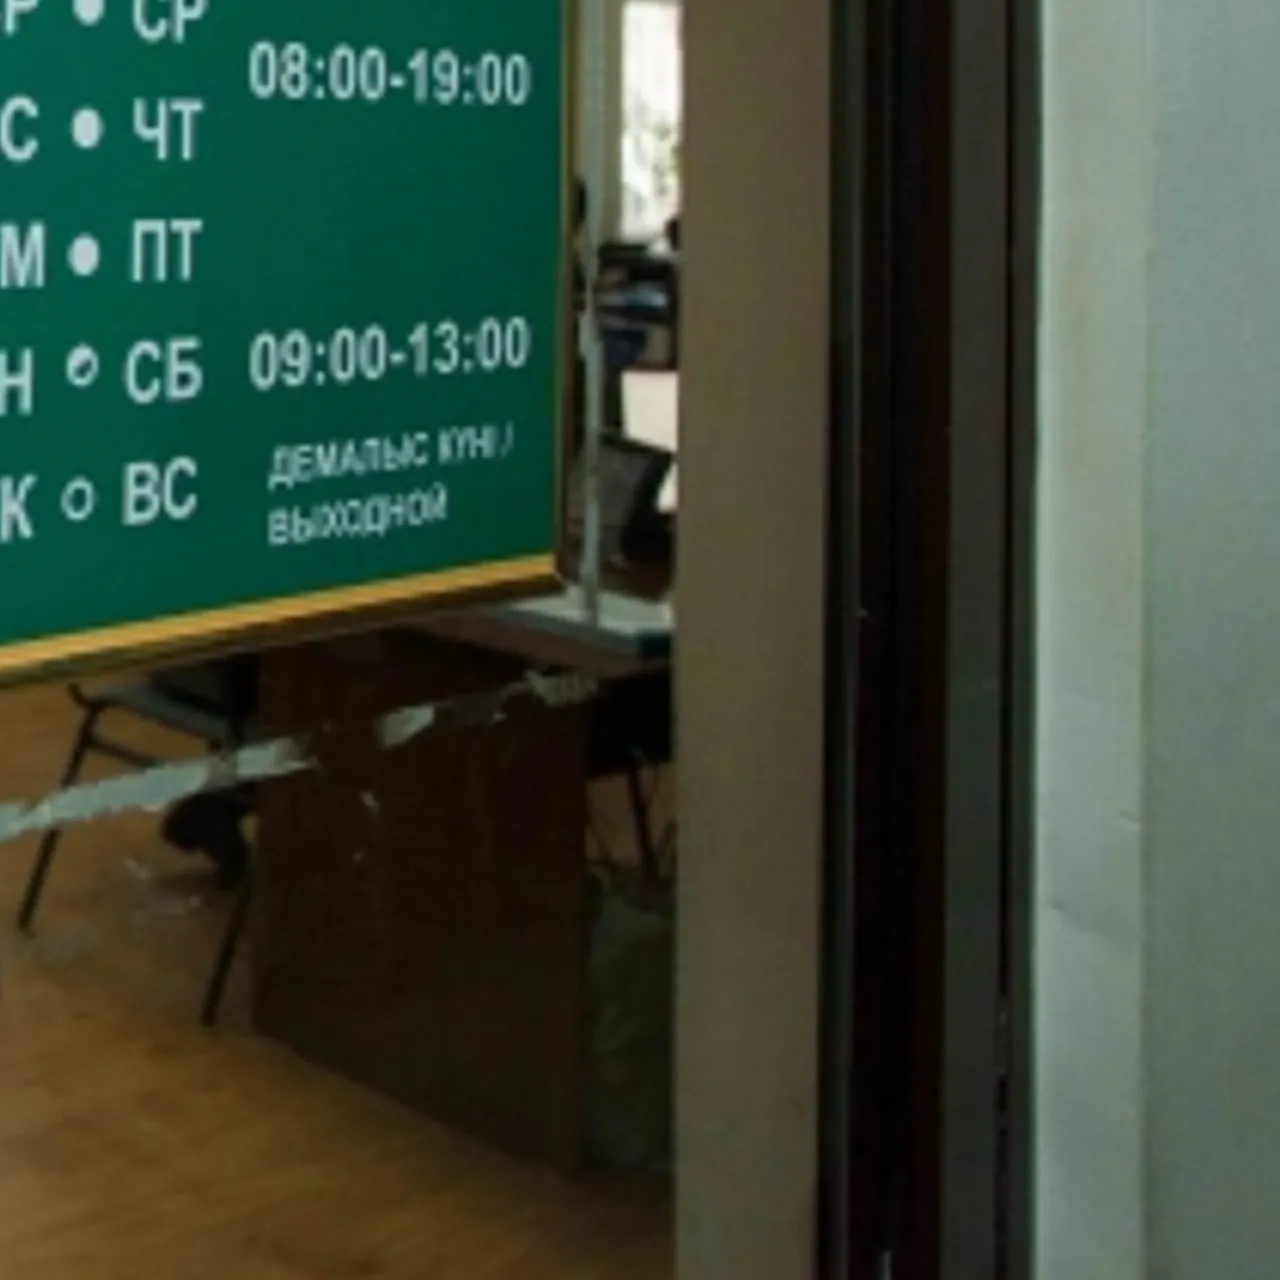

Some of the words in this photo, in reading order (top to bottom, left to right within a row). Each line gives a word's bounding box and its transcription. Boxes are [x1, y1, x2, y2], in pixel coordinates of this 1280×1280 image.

[247, 40, 533, 107] 08:00-19:00
[132, 97, 205, 161] ЧТ
[130, 219, 204, 283] ПТ
[123, 337, 203, 405] СБ
[247, 316, 533, 391] 09:00-13:00
[121, 456, 199, 527] ВС
[266, 430, 430, 493] ДЕМАЛЫС
[266, 480, 449, 548] ВЫХОДНОЙ
